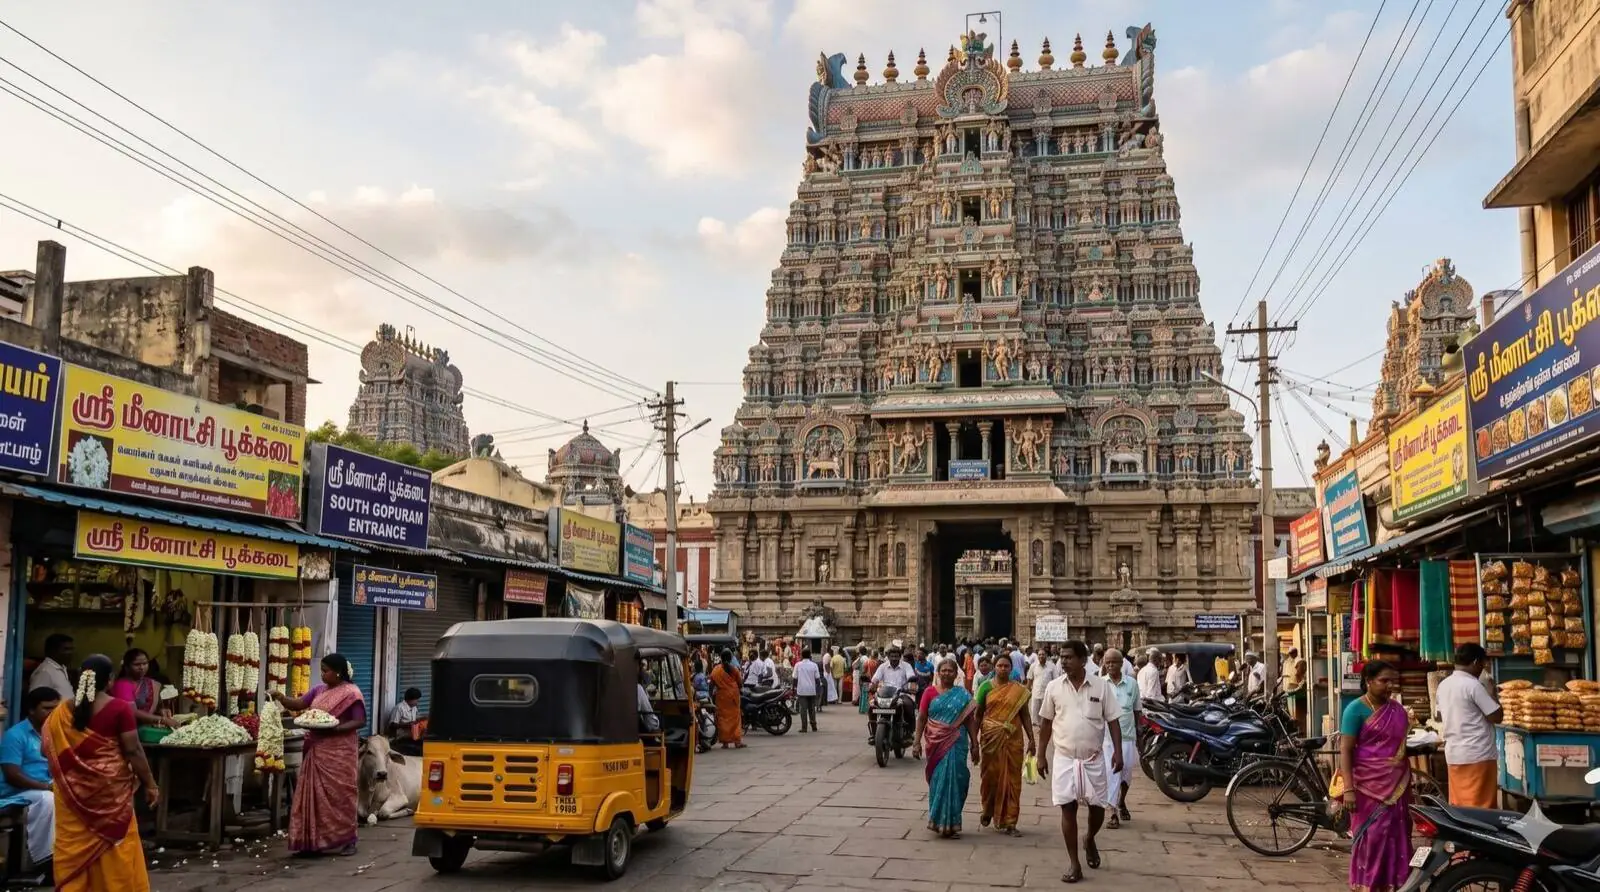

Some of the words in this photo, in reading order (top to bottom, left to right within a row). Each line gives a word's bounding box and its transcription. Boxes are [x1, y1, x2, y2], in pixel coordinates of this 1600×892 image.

[122, 393, 215, 447] மீனாட்சி
[221, 425, 299, 462] பூக்கடை
[345, 461, 387, 493] மீனாட்சி
[388, 478, 427, 503] பூக்கடை
[330, 494, 370, 515] SOUTH
[372, 502, 424, 525] GOPURAM
[348, 517, 407, 540] ENTRANCE
[130, 526, 216, 560] மீனாட்சி
[222, 543, 294, 569] பூக்கடை
